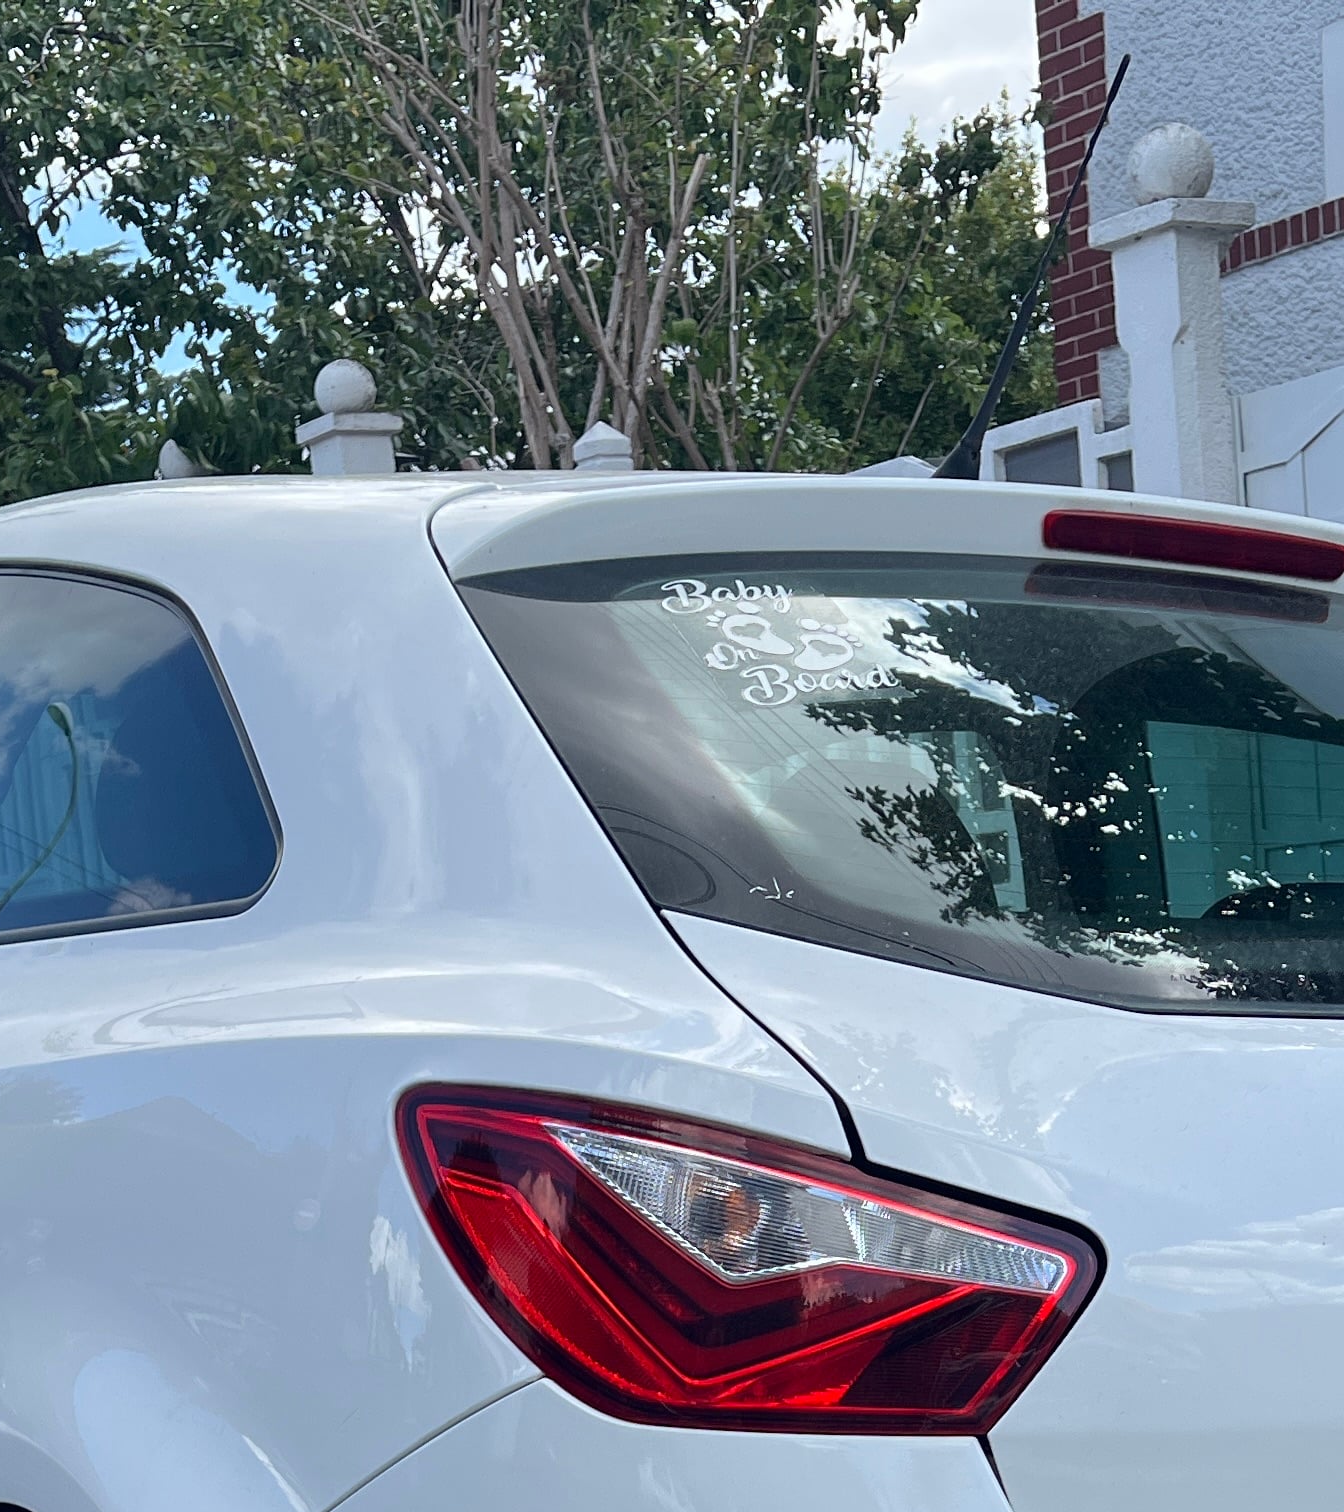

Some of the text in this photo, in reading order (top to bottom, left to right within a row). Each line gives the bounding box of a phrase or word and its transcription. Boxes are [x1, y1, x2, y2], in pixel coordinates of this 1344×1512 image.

[661, 578, 793, 614] Baby
[705, 642, 760, 671] On
[741, 664, 899, 706] Board
